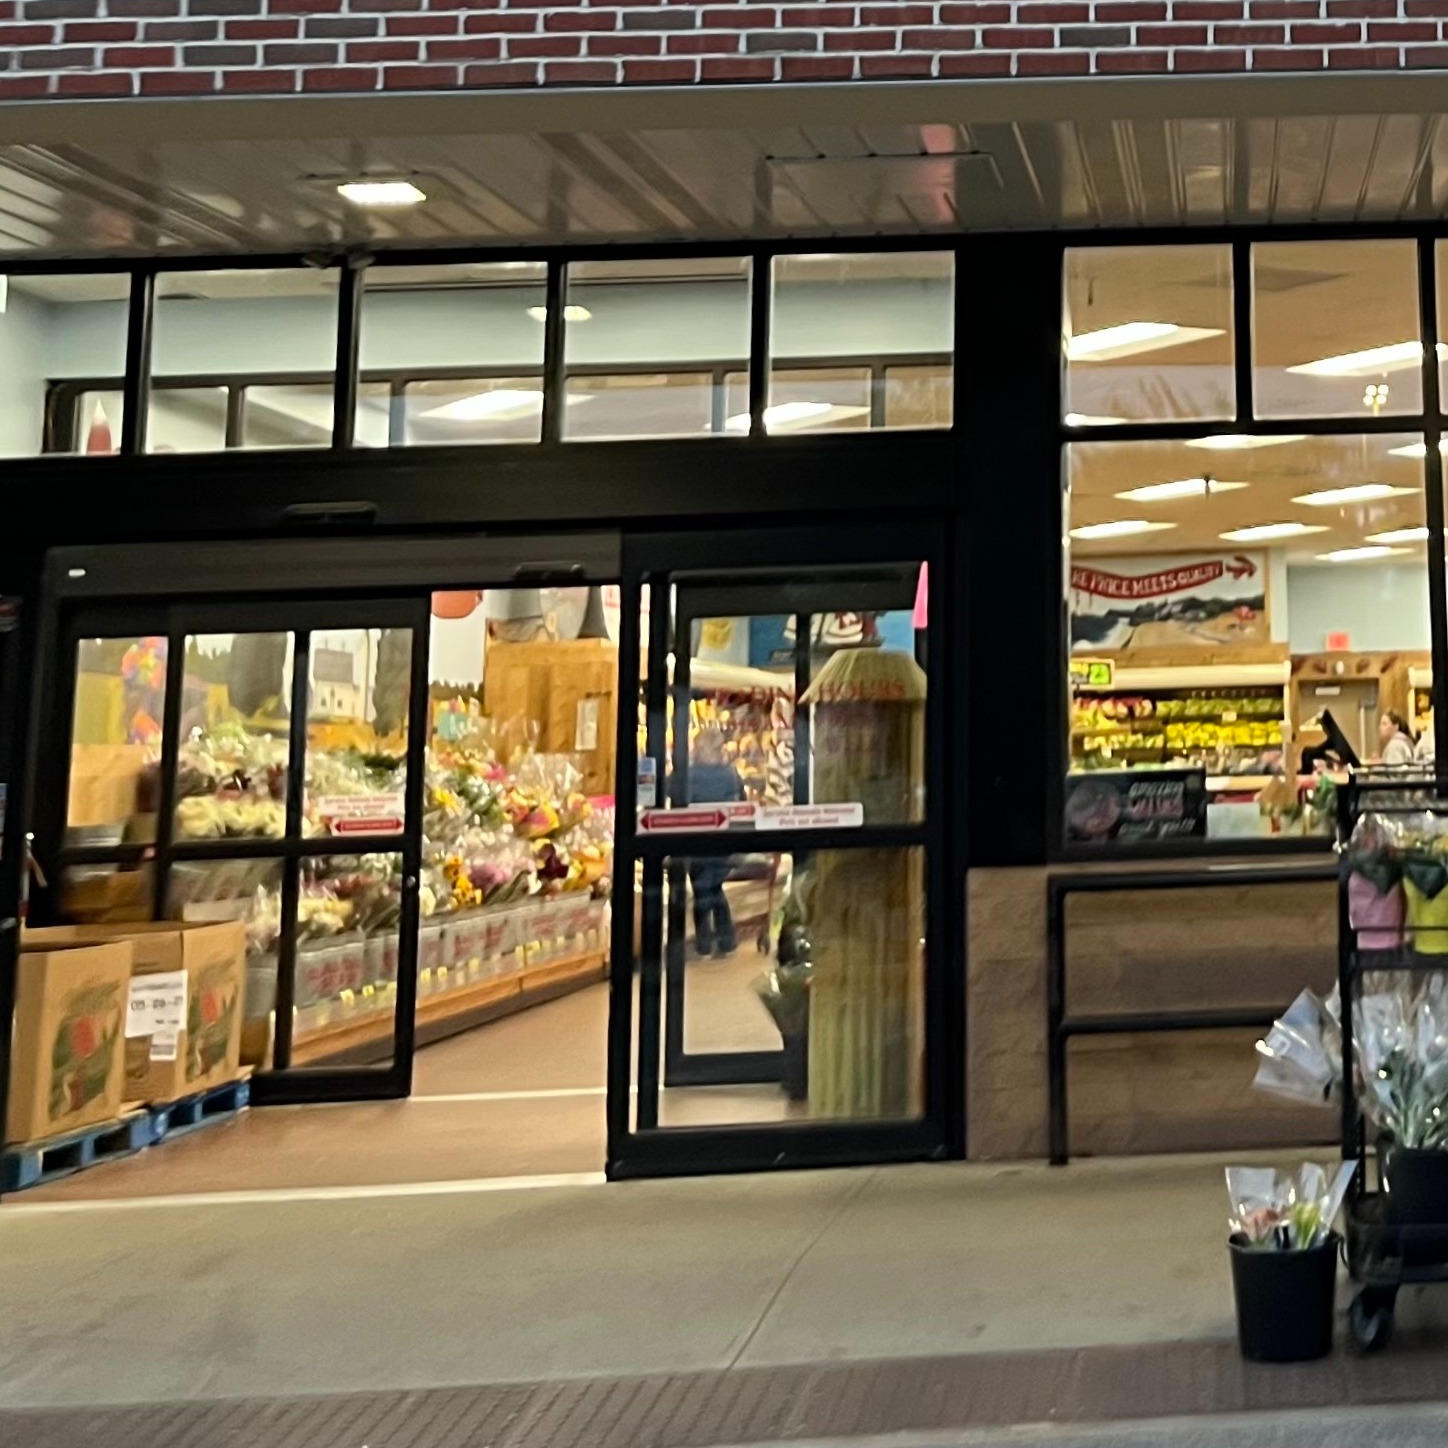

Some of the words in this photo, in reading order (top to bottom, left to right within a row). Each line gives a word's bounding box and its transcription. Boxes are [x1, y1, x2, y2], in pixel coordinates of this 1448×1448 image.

[1090, 573, 1131, 595] PRICE
[1132, 573, 1177, 596] MEETS
[1176, 564, 1221, 584] QUALITY
